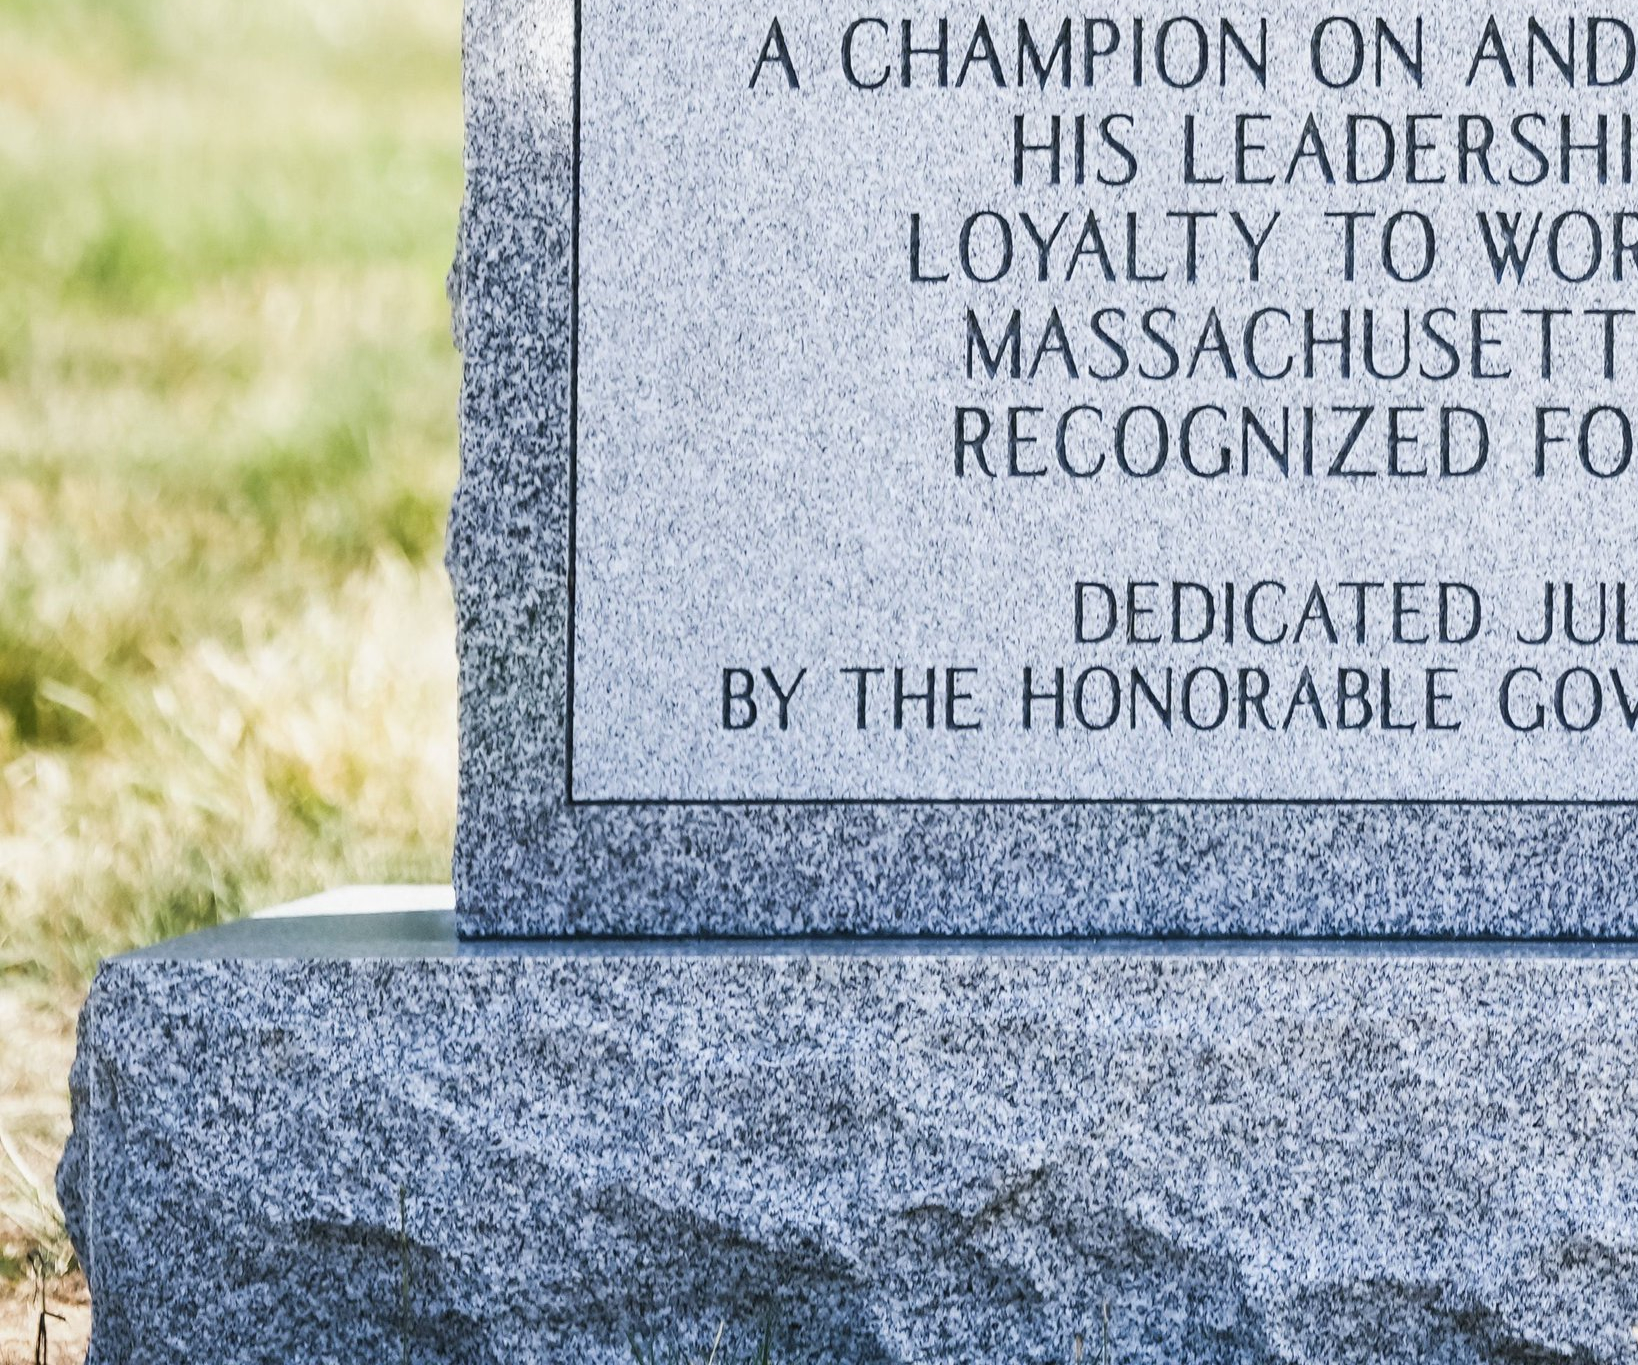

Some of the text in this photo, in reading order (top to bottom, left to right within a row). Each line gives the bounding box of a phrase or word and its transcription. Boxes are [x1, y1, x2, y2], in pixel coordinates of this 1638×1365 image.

[748, 17, 800, 90] A
[840, 14, 1268, 92] CHAMPION
[1310, 15, 1424, 90] ON
[1465, 15, 1637, 88] AND
[1012, 112, 1139, 188] HIS
[909, 209, 1281, 284] LOYALTY
[1324, 209, 1437, 284] TO
[953, 403, 1490, 480] RECOGNIZED
[1073, 579, 1483, 646] DEDICATED
[721, 665, 808, 732] BY
[840, 665, 983, 732] THE
[1021, 664, 1462, 733] HONORABLE
